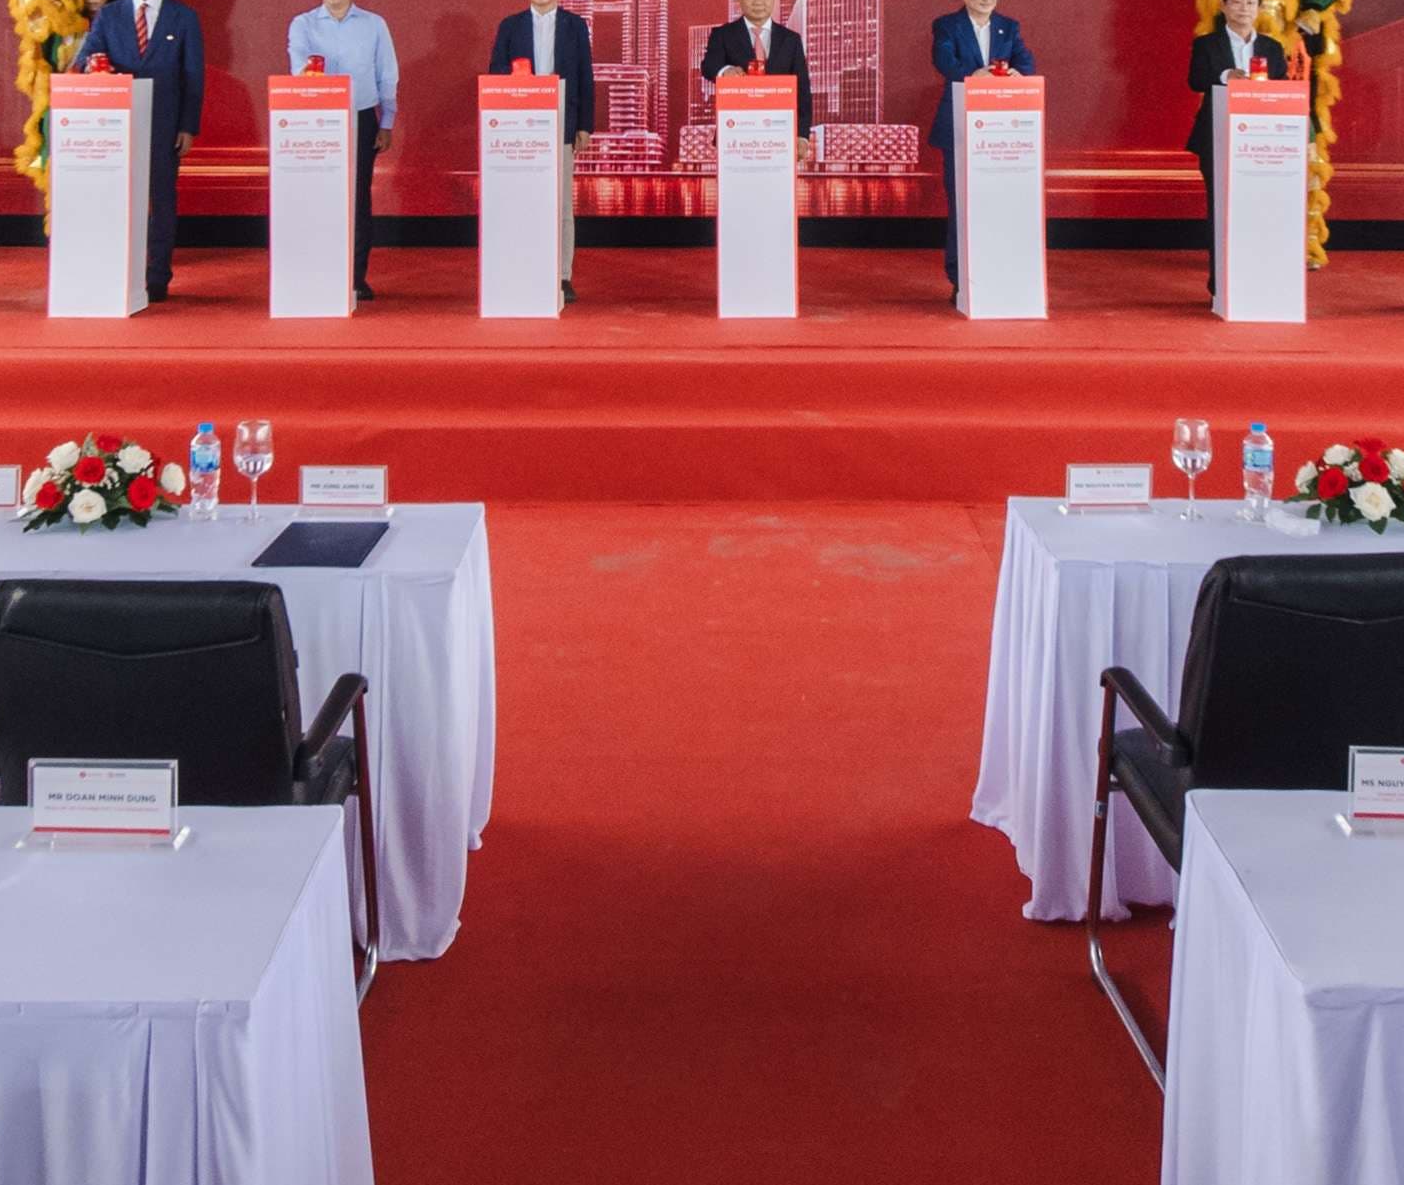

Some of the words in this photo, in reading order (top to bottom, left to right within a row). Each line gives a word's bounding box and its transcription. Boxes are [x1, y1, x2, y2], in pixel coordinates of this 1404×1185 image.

[1361, 779, 1375, 787] MS
[48, 793, 64, 801] MR
[98, 793, 124, 802] MINH
